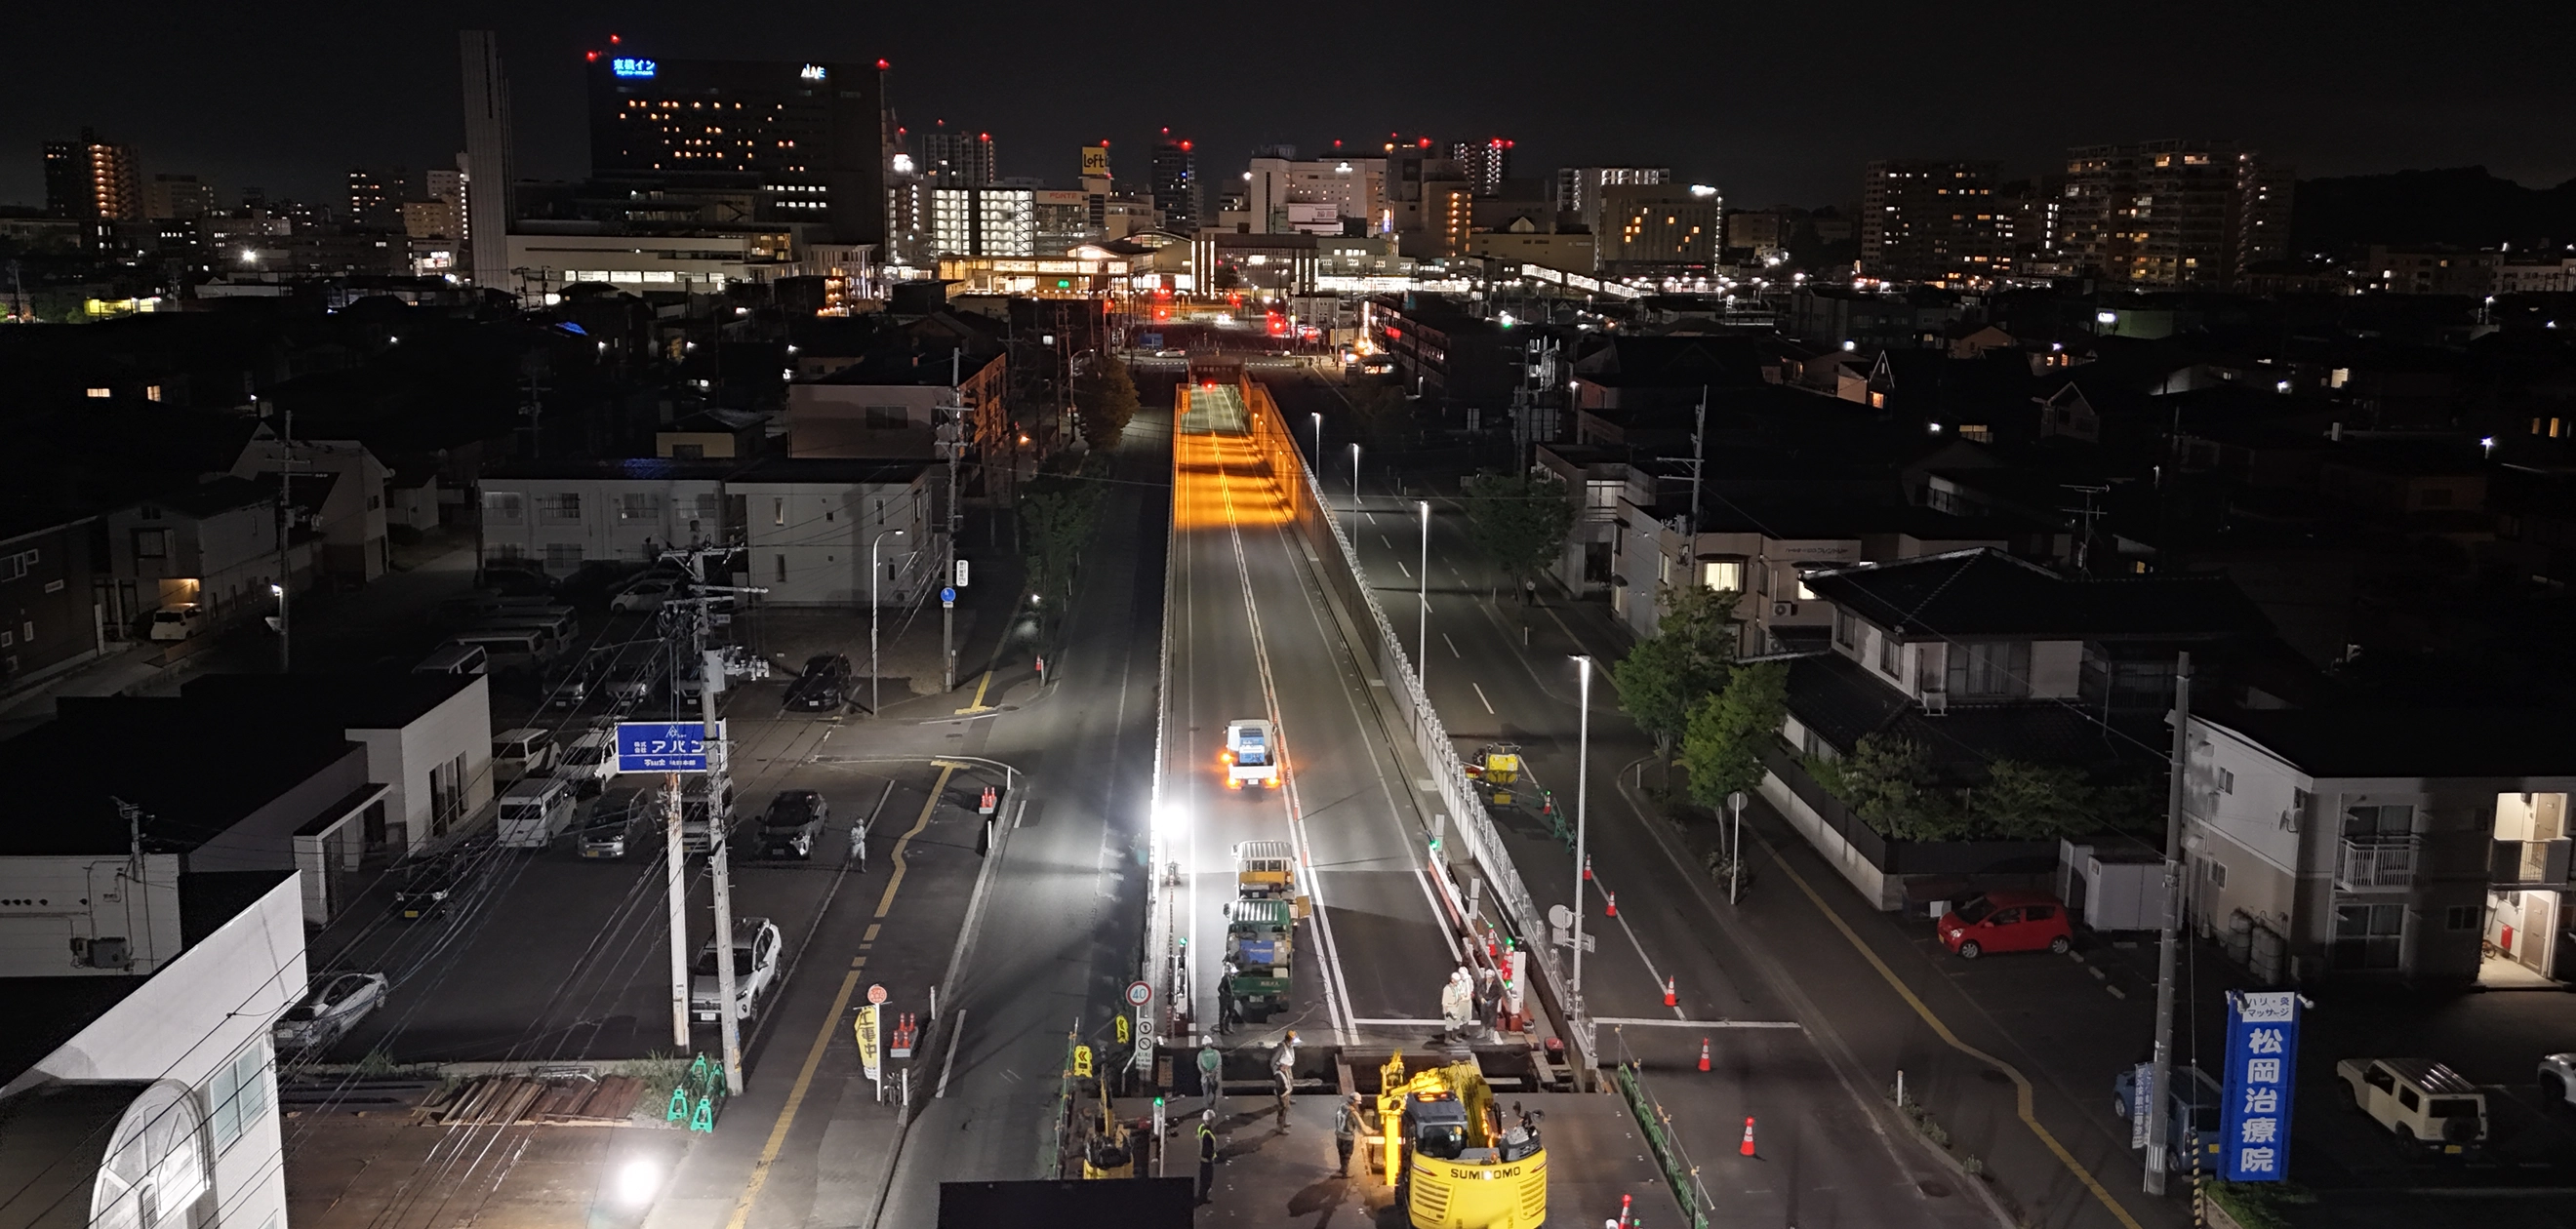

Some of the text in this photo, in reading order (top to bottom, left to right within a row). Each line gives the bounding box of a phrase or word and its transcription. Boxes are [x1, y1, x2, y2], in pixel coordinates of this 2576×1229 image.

[1083, 153, 1105, 168] Loft
[651, 740, 705, 753] アバン
[1132, 988, 1147, 999] 40
[2247, 1008, 2289, 1017] マッサージ
[860, 1011, 877, 1058] 工事中
[2240, 1027, 2283, 1173] 松岡治療院
[1450, 1166, 1521, 1180] SUMIOMO
